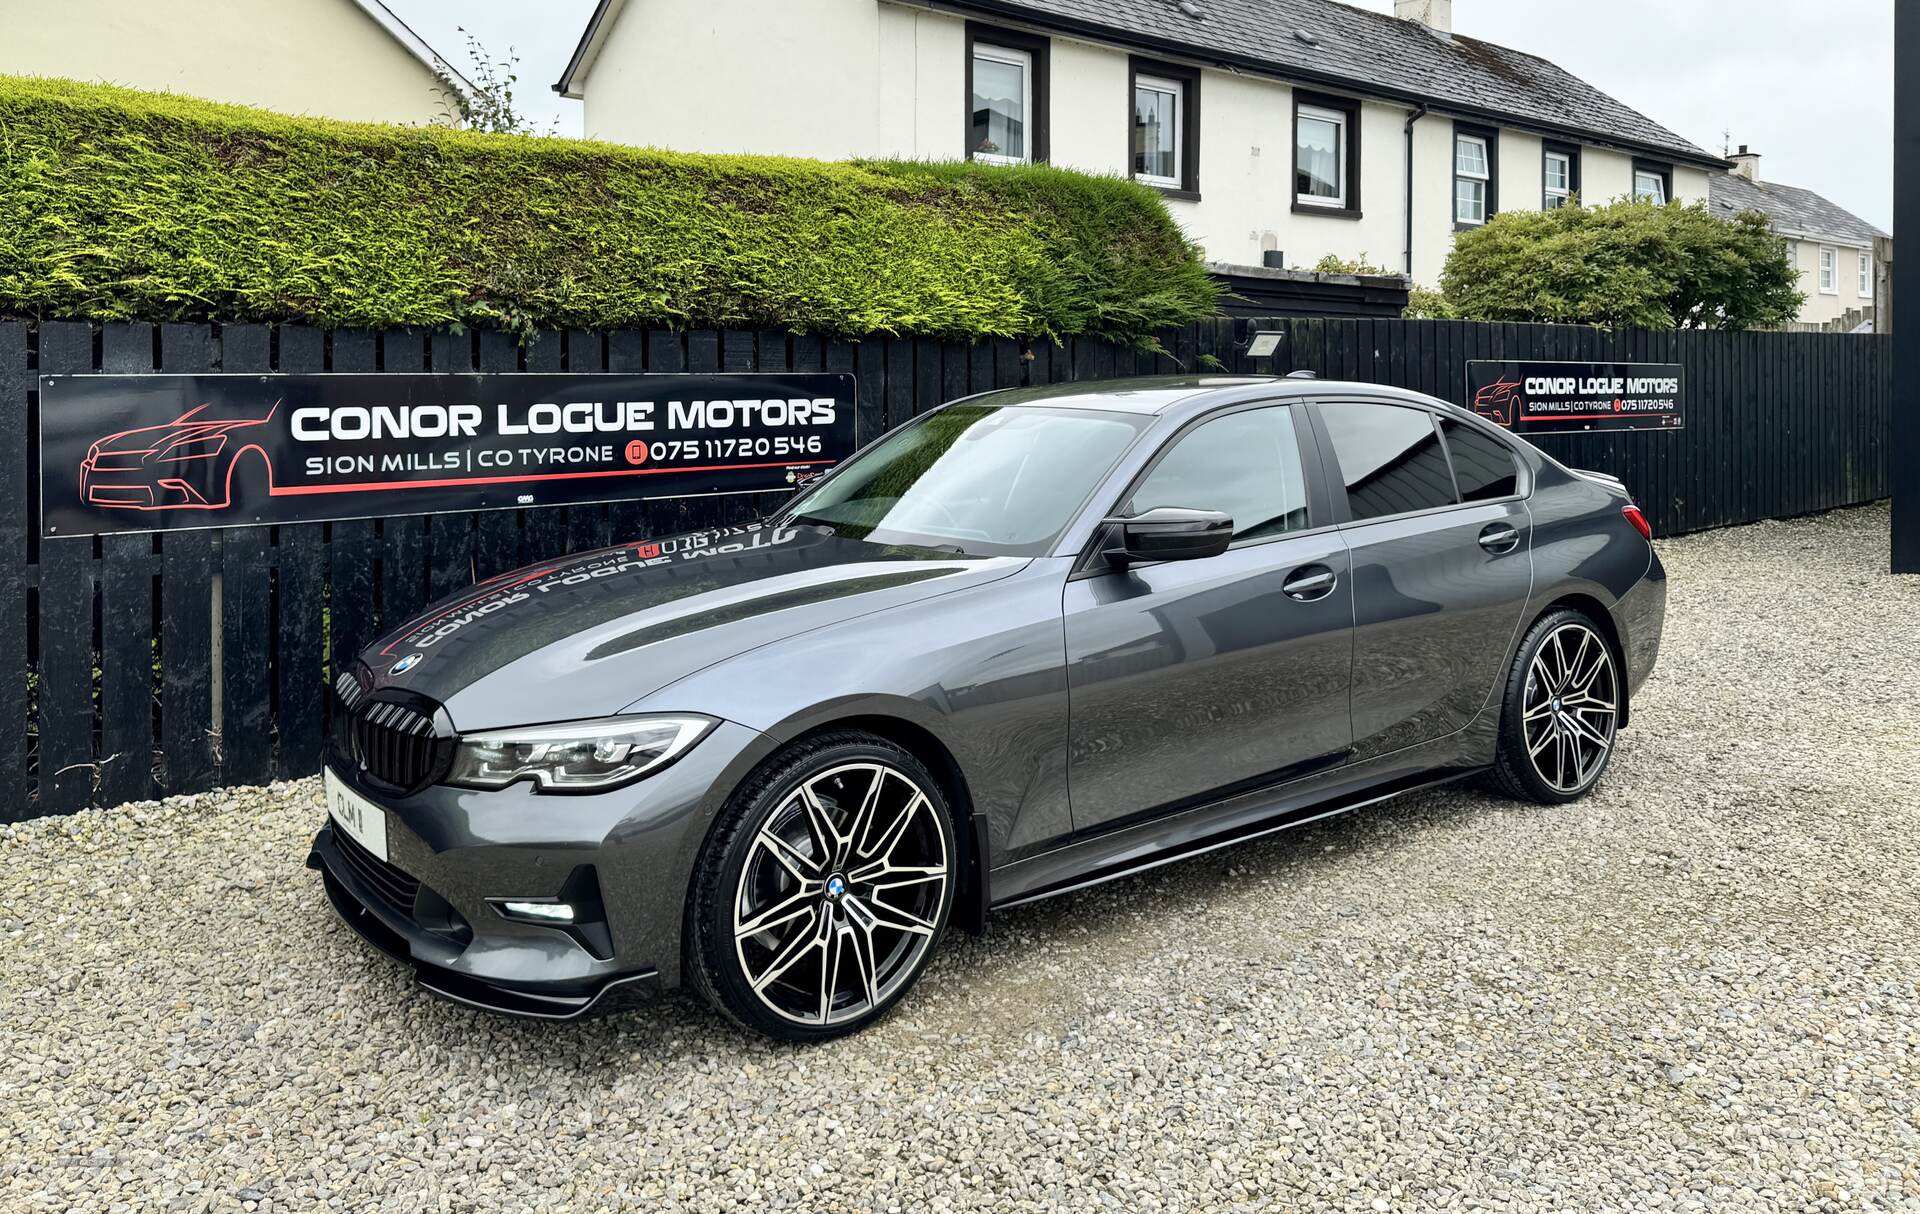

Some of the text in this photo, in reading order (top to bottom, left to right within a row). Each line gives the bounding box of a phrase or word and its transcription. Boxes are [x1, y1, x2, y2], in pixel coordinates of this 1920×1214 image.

[1525, 377, 1678, 395] CONOR LOGUE MOTORS
[1529, 401, 1548, 412] SION
[1584, 400, 1611, 410] TYRONE
[291, 398, 836, 441] CONOR LOGUE MOTORS
[305, 454, 374, 475] SION
[381, 451, 461, 472] MILLS
[477, 449, 513, 467] CO
[518, 445, 613, 465] TYRONE
